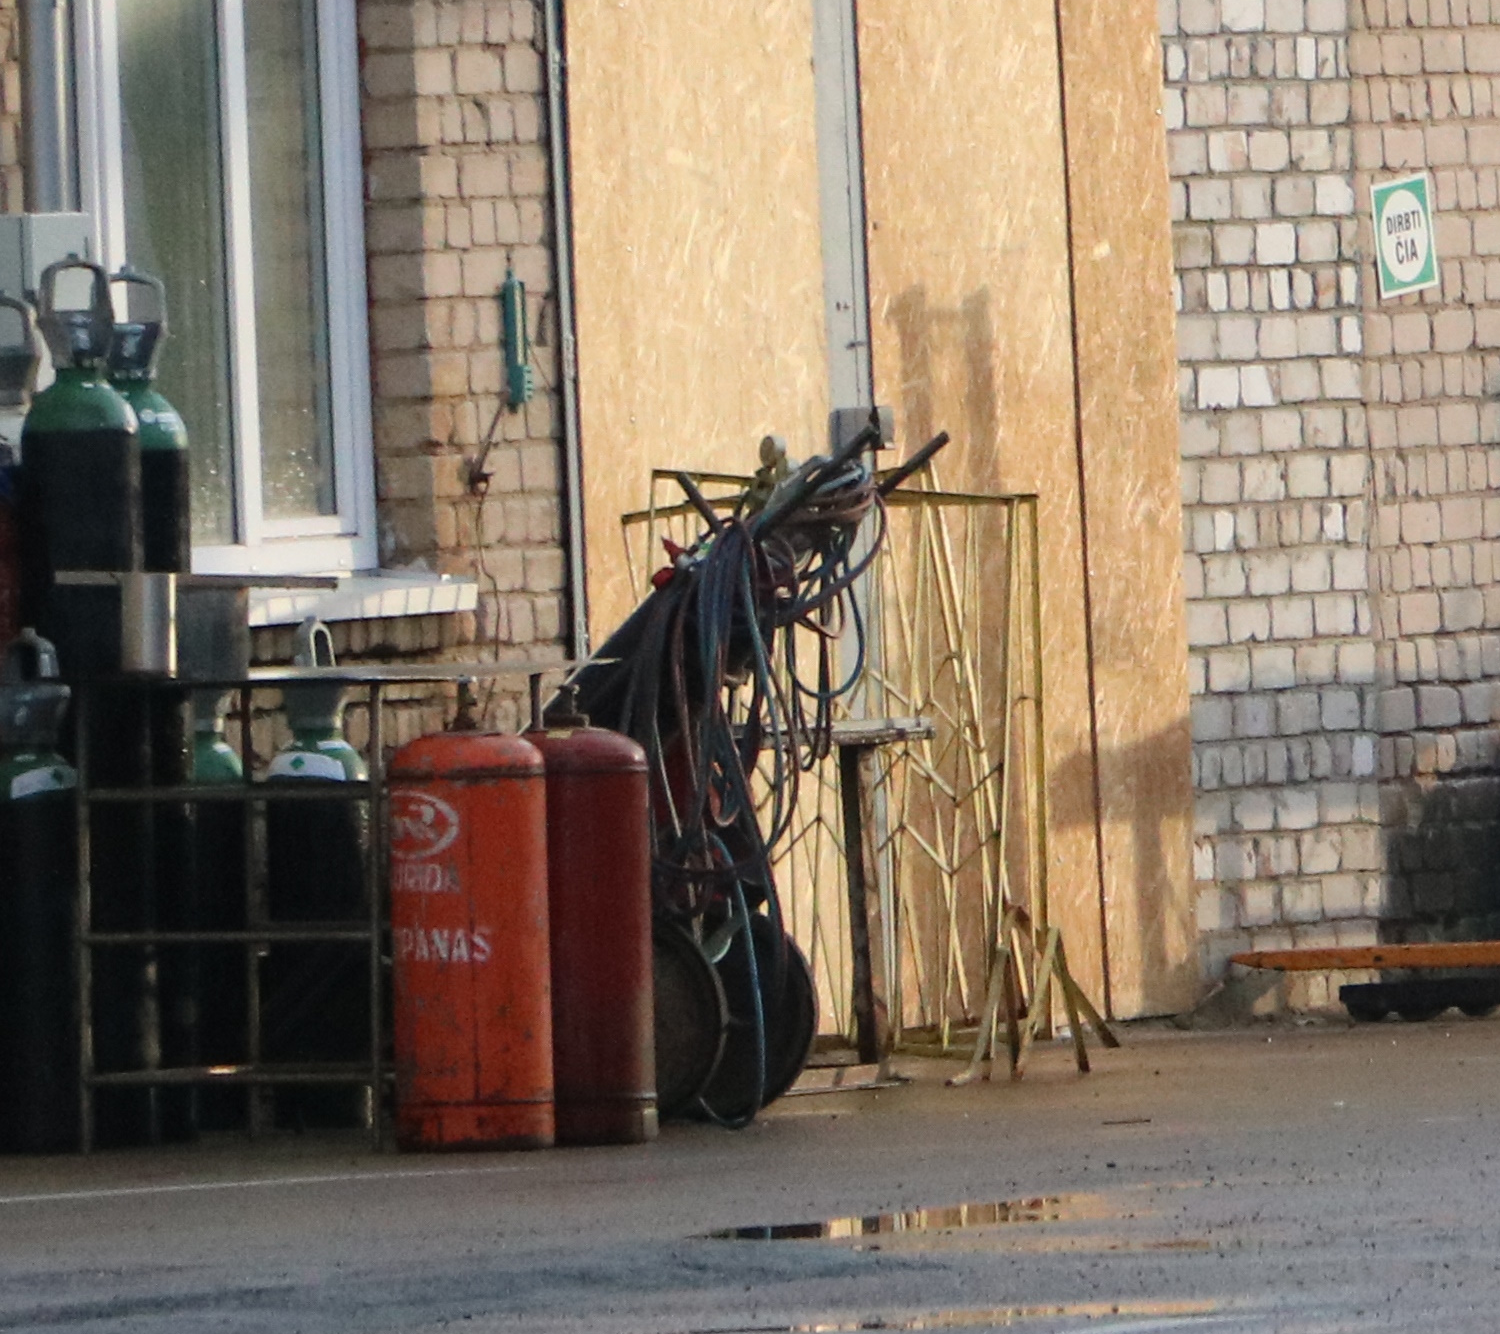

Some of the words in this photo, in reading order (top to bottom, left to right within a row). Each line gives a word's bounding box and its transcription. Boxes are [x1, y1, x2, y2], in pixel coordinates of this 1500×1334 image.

[1386, 210, 1422, 236] DIRBTI
[1395, 235, 1419, 265] ČIA
[394, 927, 493, 963] PANAS
